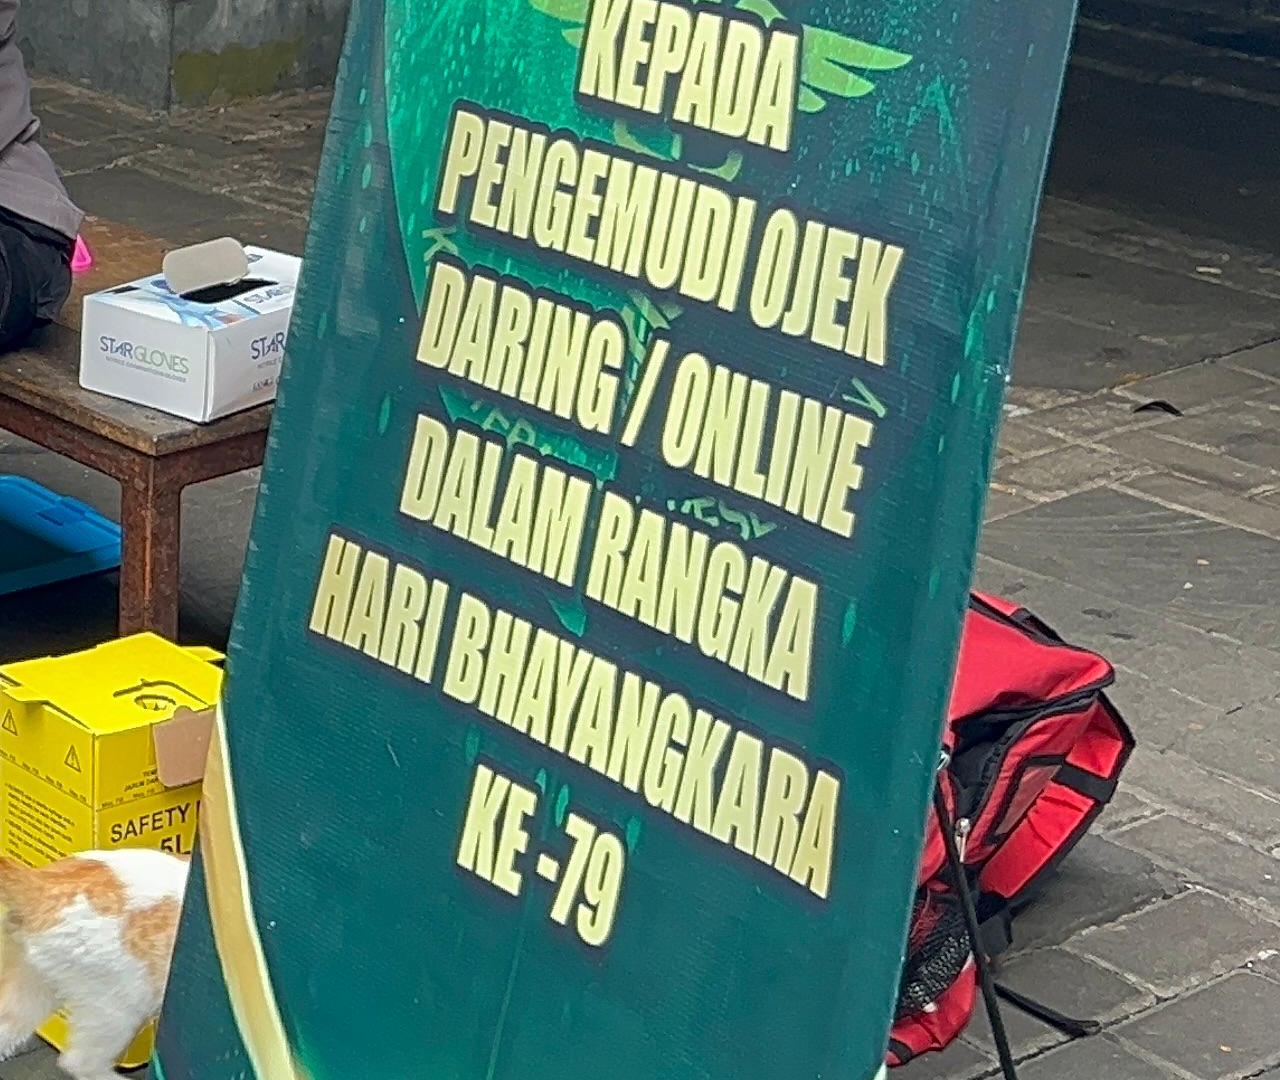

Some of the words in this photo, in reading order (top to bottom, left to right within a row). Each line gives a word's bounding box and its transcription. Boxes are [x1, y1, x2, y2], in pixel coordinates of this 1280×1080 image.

[436, 107, 760, 332] PENGEMUDI
[747, 207, 906, 369] OJEK
[415, 262, 628, 448] DARING
[620, 337, 670, 449] /
[661, 354, 876, 541] ONLINE
[398, 412, 597, 592] DALAM
[585, 484, 821, 703] RANGKA
[110, 801, 192, 844] SAFETY
[308, 532, 451, 684] HARI
[441, 588, 843, 903] BHAYANGKARA
